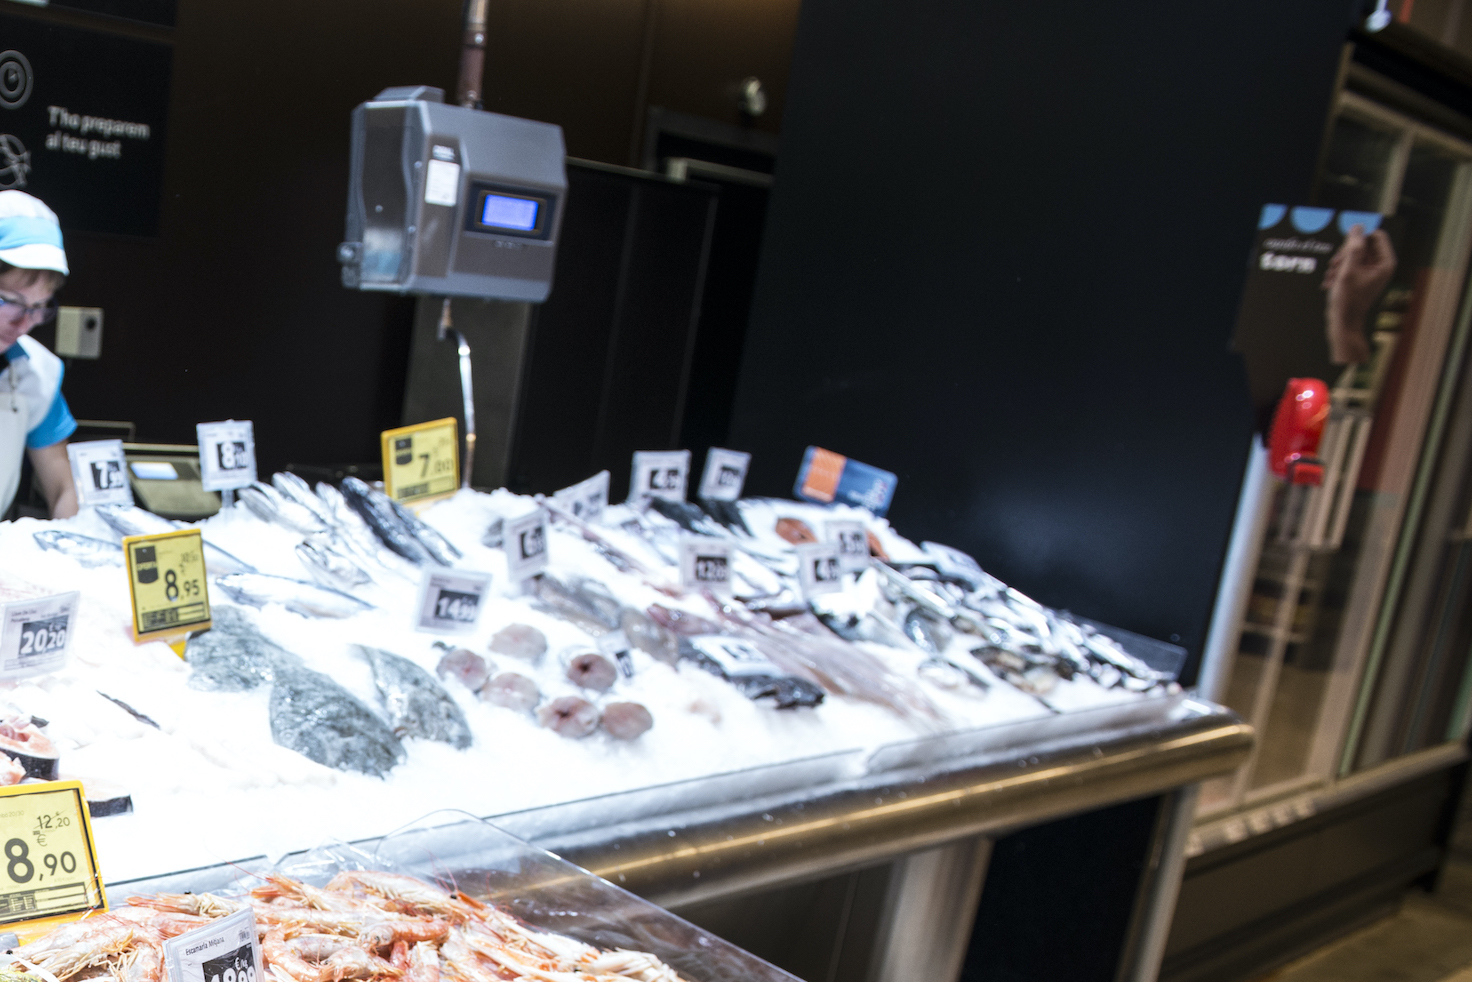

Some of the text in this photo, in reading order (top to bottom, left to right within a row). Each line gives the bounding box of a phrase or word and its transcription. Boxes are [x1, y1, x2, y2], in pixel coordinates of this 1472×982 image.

[164, 568, 200, 602] 8,95
[36, 814, 71, 830] 12,20
[4, 837, 77, 884] 8,90
